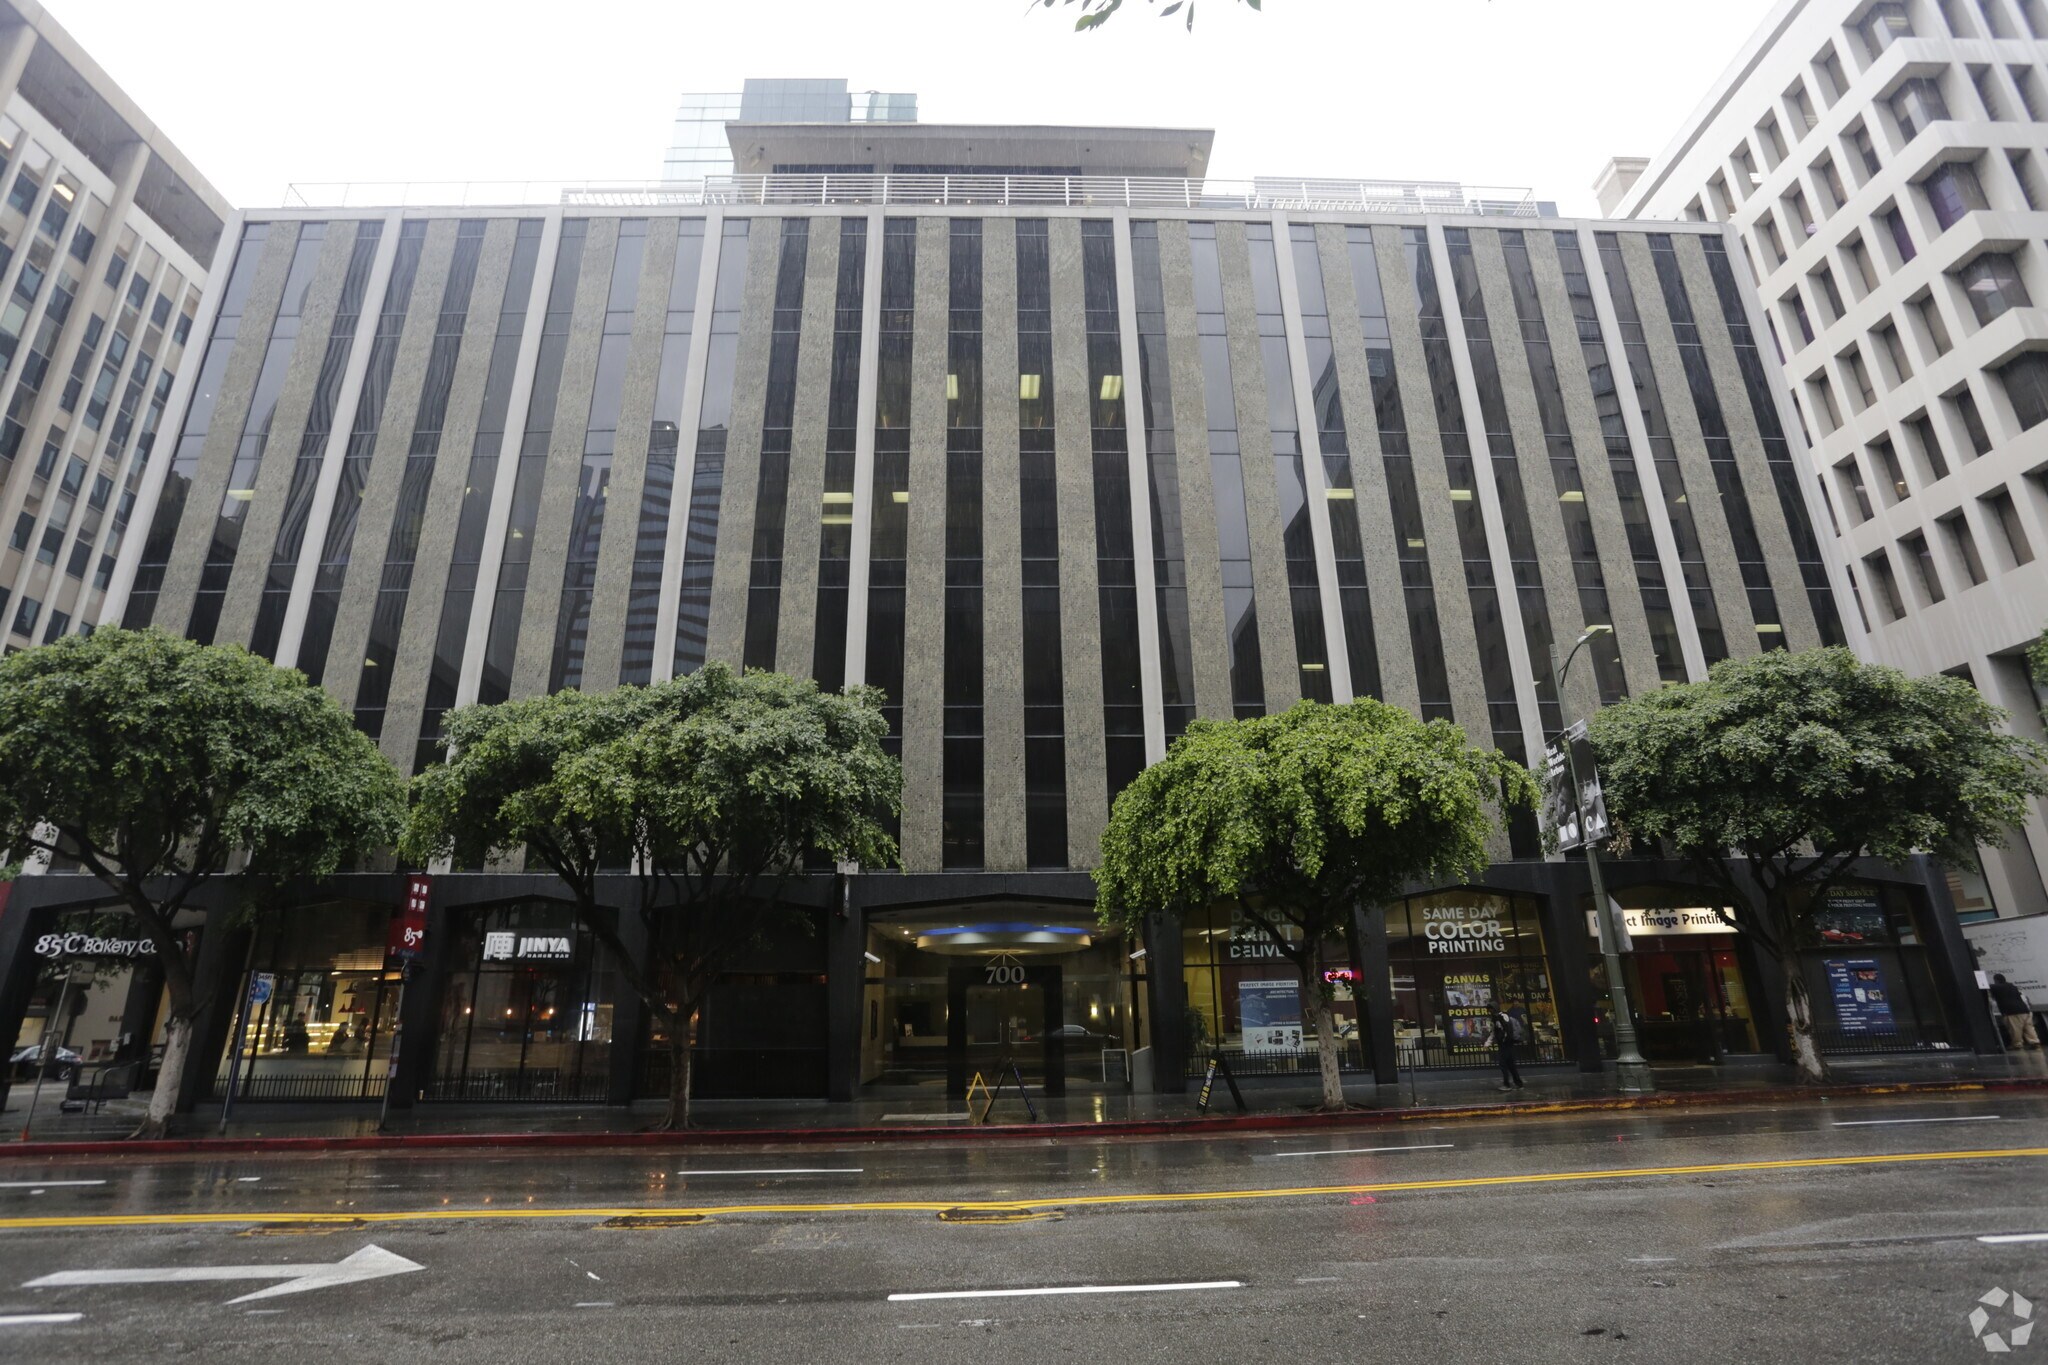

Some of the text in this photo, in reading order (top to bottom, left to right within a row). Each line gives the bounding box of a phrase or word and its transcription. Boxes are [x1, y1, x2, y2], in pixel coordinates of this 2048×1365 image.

[1231, 908, 1294, 922] DIGN
[1422, 906, 1498, 920] SAME DAY
[1641, 914, 1678, 928] Image
[1682, 913, 1726, 925] Printin
[1424, 920, 1502, 940] COLOR
[84, 938, 139, 957] Bakery
[517, 937, 571, 958] JINYA
[1428, 939, 1505, 954] PRINTING
[985, 966, 1025, 984] 700
[1444, 974, 1490, 984] CANVAS
[1448, 1007, 1493, 1017] POSTER
